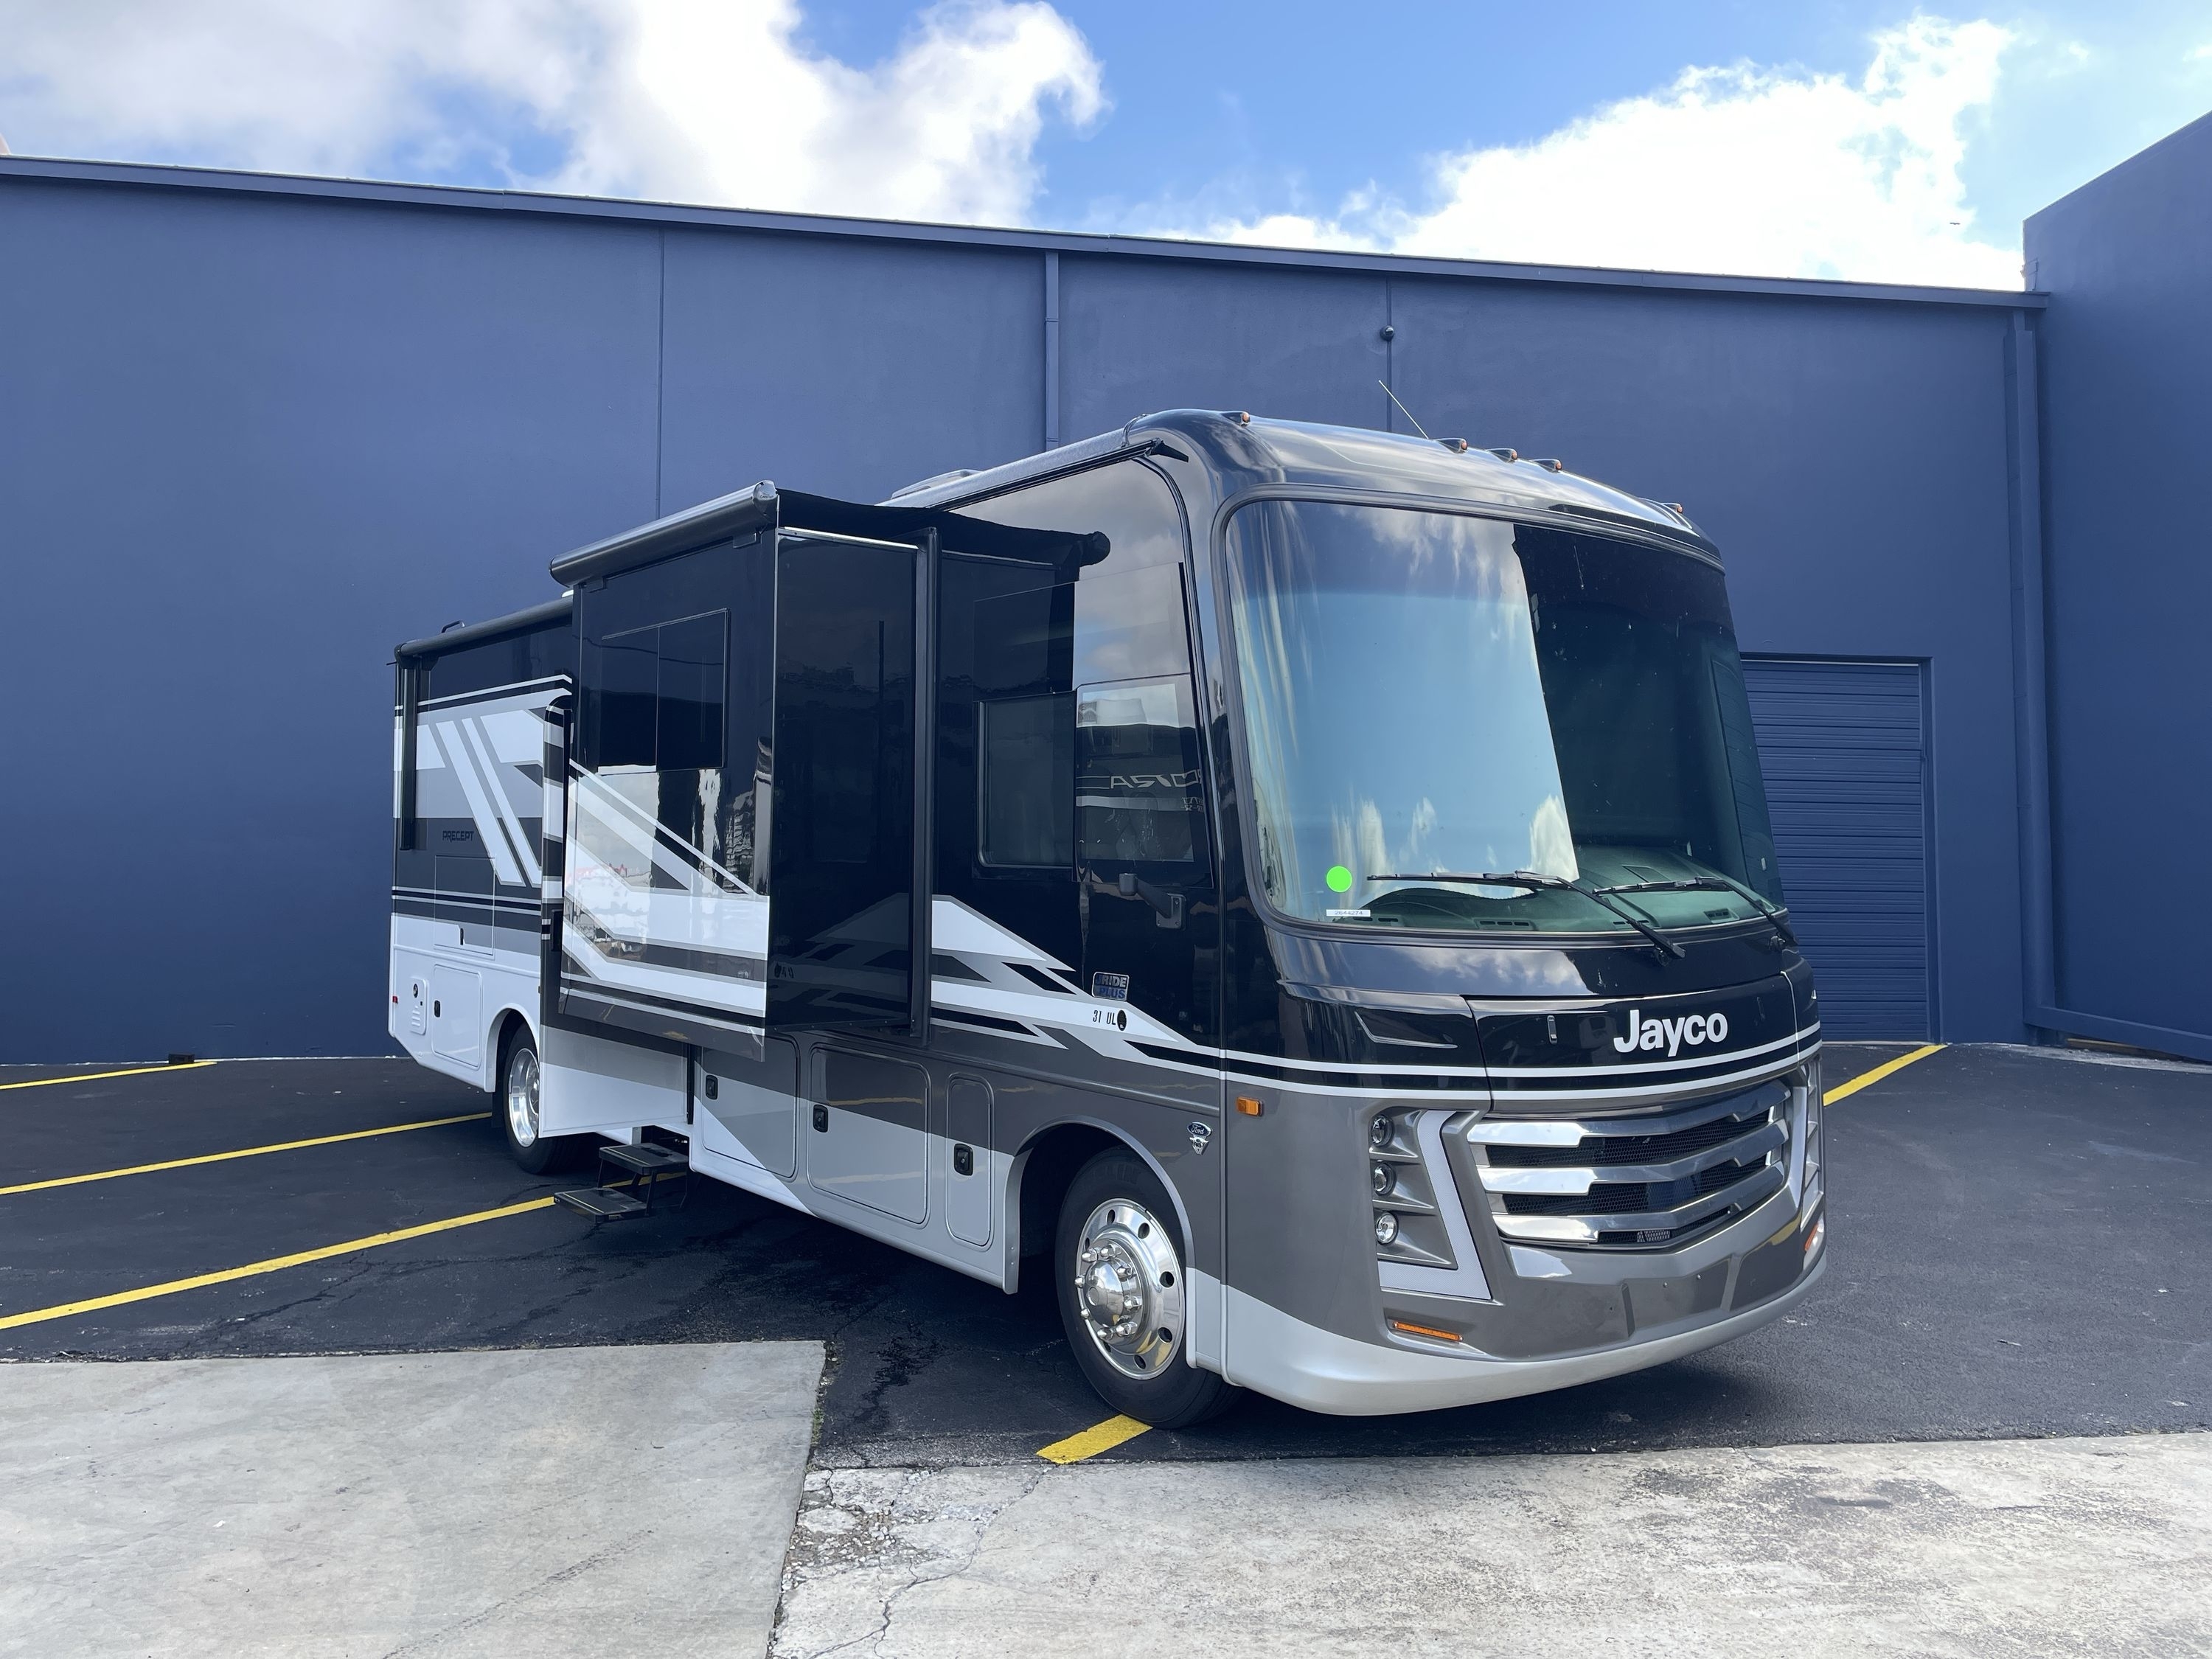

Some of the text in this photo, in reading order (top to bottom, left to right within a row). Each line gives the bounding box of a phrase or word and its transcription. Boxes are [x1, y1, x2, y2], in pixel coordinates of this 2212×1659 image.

[442, 830, 474, 842] PRECEPT
[1099, 987, 1125, 999] PLUS
[1093, 1009, 1102, 1023] 31
[1106, 1012, 1116, 1026] UL
[1613, 1009, 1728, 1057] Jayco
[1191, 1124, 1205, 1135] Ford
